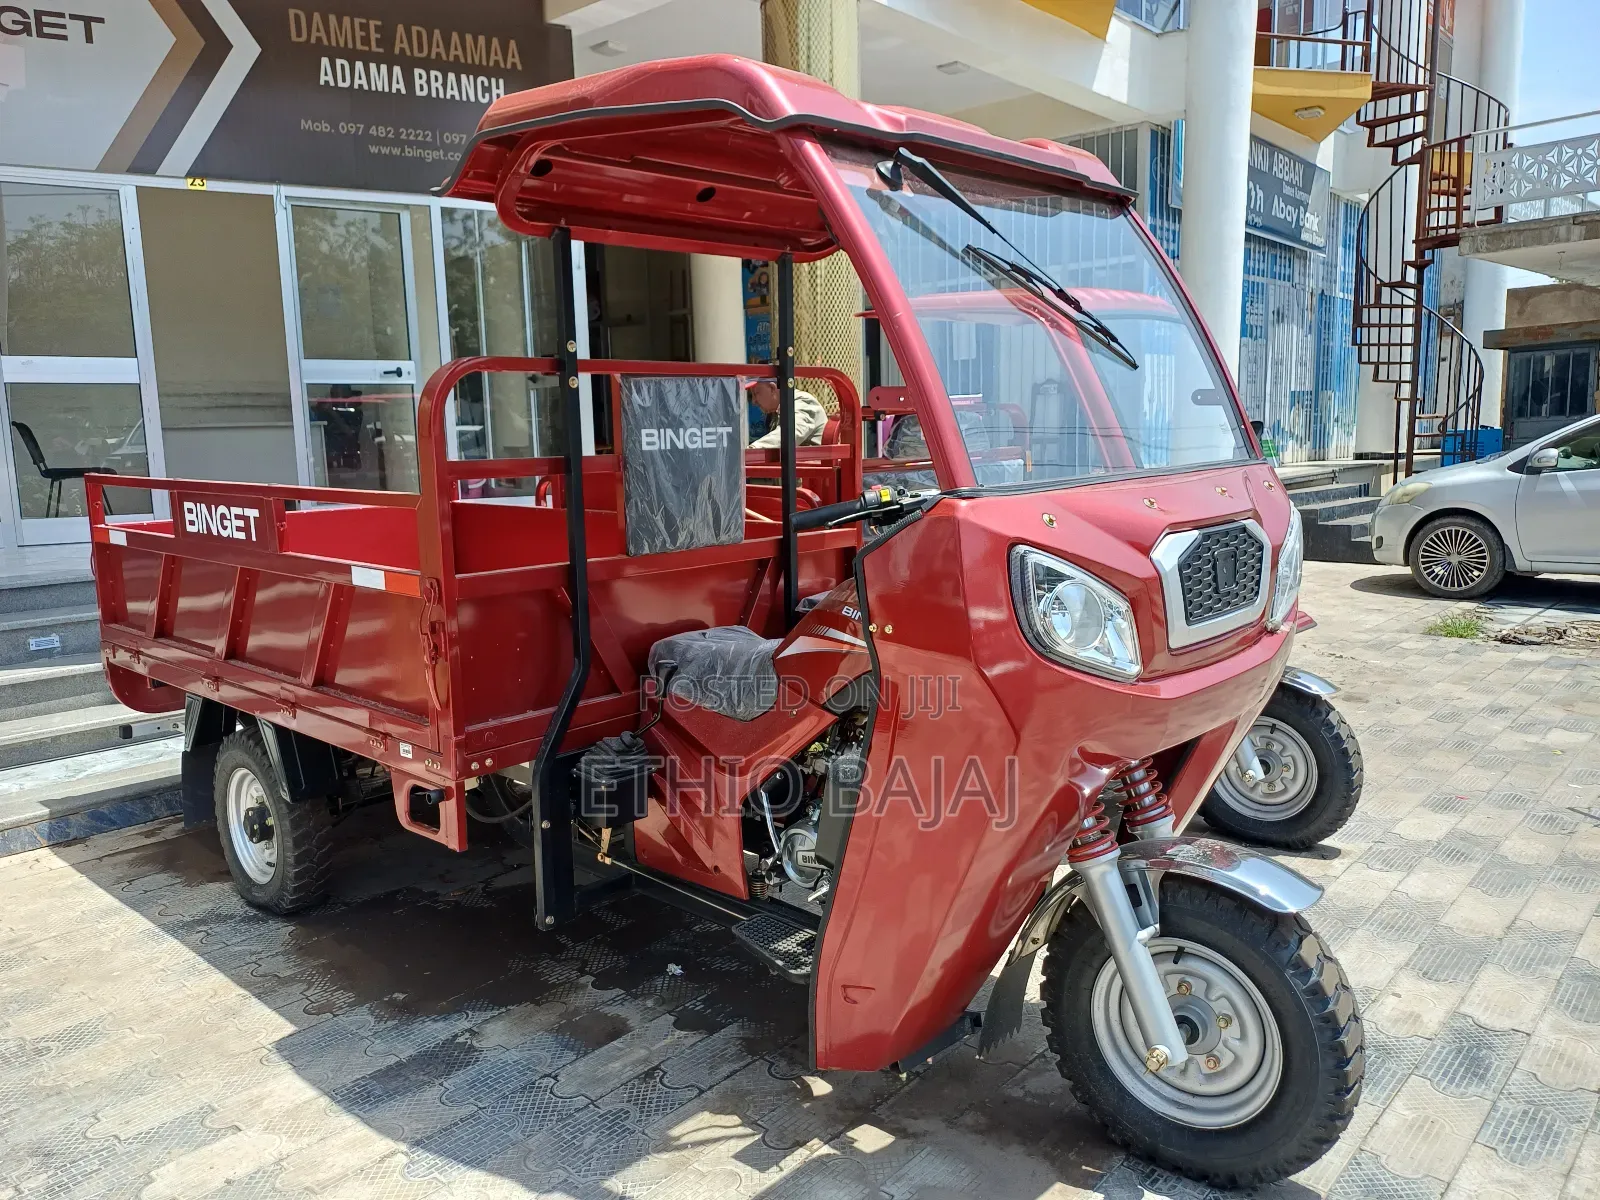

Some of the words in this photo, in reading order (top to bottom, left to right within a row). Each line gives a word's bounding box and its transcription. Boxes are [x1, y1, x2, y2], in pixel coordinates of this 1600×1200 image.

[0, 5, 105, 44] GET
[288, 8, 384, 53] DAMEE
[394, 24, 522, 71] ADAAMAA
[319, 56, 406, 95] ADAMA
[413, 68, 505, 104] BRANCH
[300, 119, 335, 133] Mob.
[339, 122, 364, 135] 097
[369, 125, 395, 139] 482
[400, 128, 432, 142] 2222
[1272, 151, 1304, 188] ABBAAY
[1272, 194, 1298, 229] Abay
[1299, 205, 1320, 233] Bank
[641, 426, 733, 451] BINGET
[183, 501, 260, 542] BINGET
